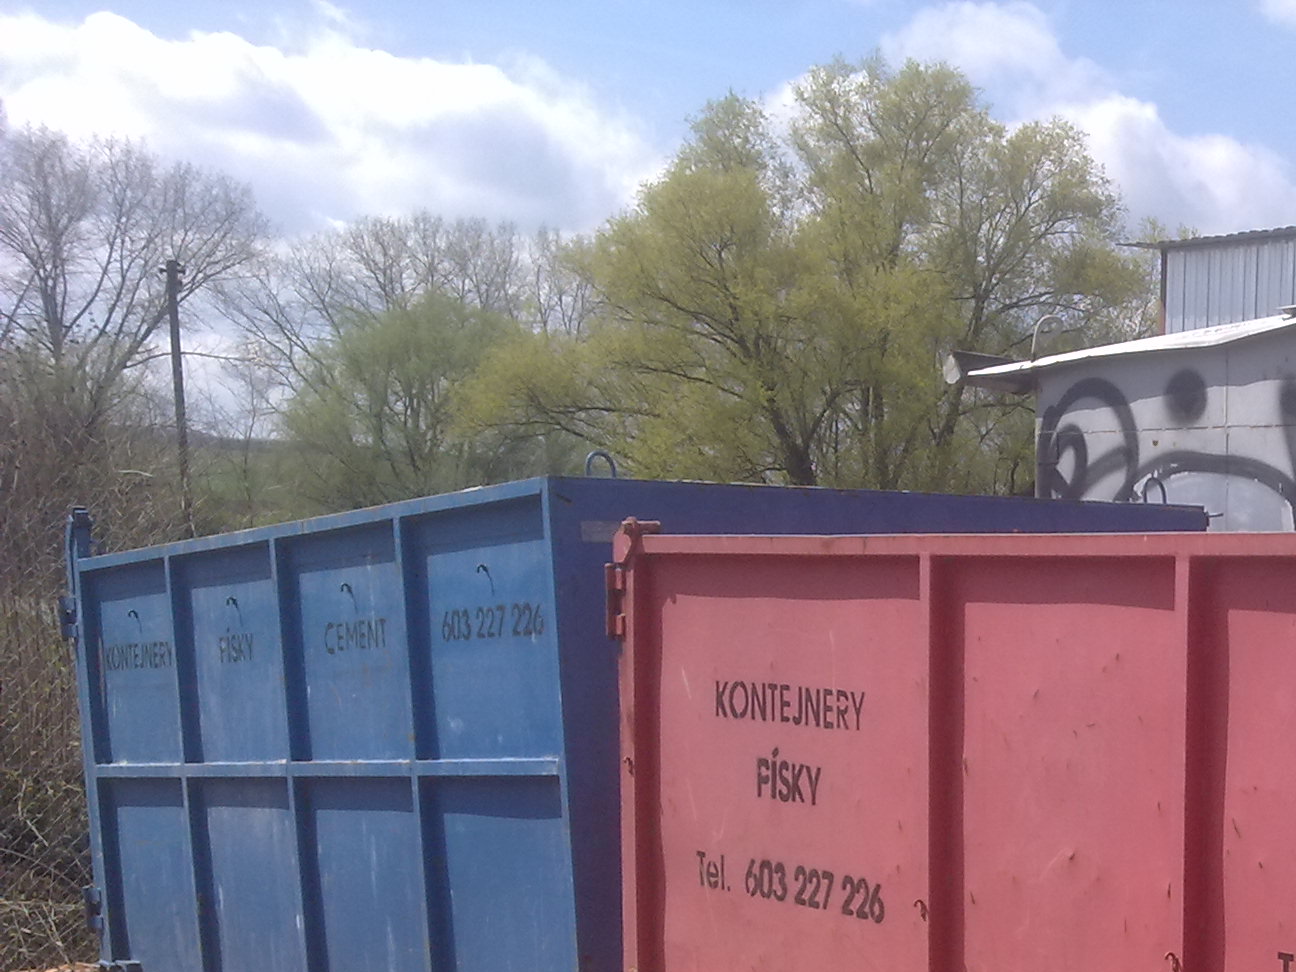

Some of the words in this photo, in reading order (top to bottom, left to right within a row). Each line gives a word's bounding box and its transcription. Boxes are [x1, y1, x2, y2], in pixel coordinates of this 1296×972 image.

[105, 640, 174, 672] KONTEJNERY
[218, 626, 254, 664] PÍSKY
[324, 617, 387, 655] CEMENT
[441, 608, 472, 642] 603
[475, 603, 507, 639] 227
[511, 601, 545, 637] 226
[714, 680, 866, 731] KONTEJNERY
[756, 746, 822, 807] PÍSKY
[696, 850, 731, 892] Tel.
[744, 857, 788, 902] 603
[793, 864, 835, 911] 227
[841, 874, 886, 925] 226
